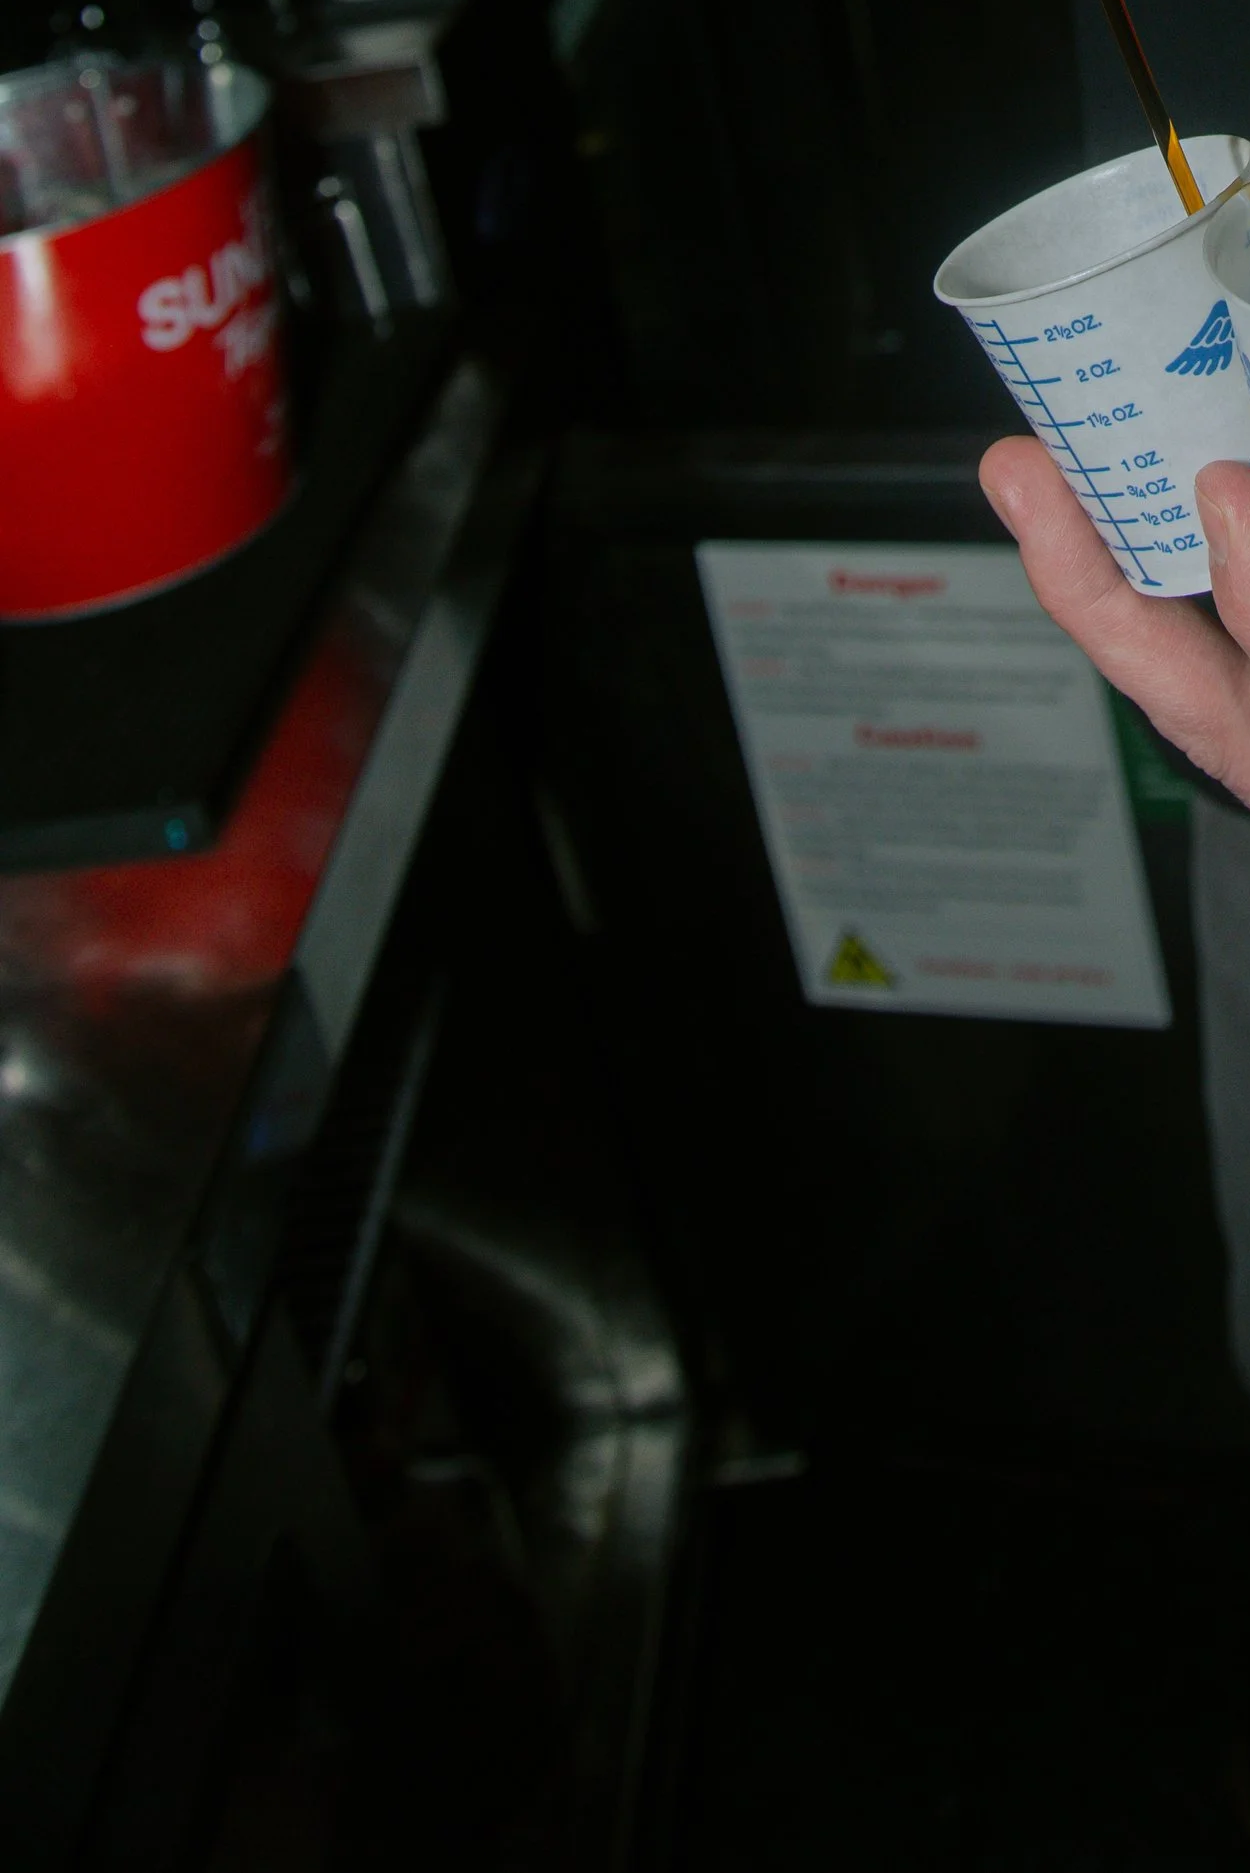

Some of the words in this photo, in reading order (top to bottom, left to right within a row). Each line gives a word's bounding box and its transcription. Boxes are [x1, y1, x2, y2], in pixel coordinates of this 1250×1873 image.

[1076, 369, 1089, 383] 2
[1090, 359, 1121, 377] OZ.
[1112, 403, 1143, 422] OZ.
[1121, 459, 1131, 472] 1
[1134, 450, 1164, 469] OZ.
[1160, 505, 1190, 522] OZ.
[1173, 533, 1203, 551] OZ.
